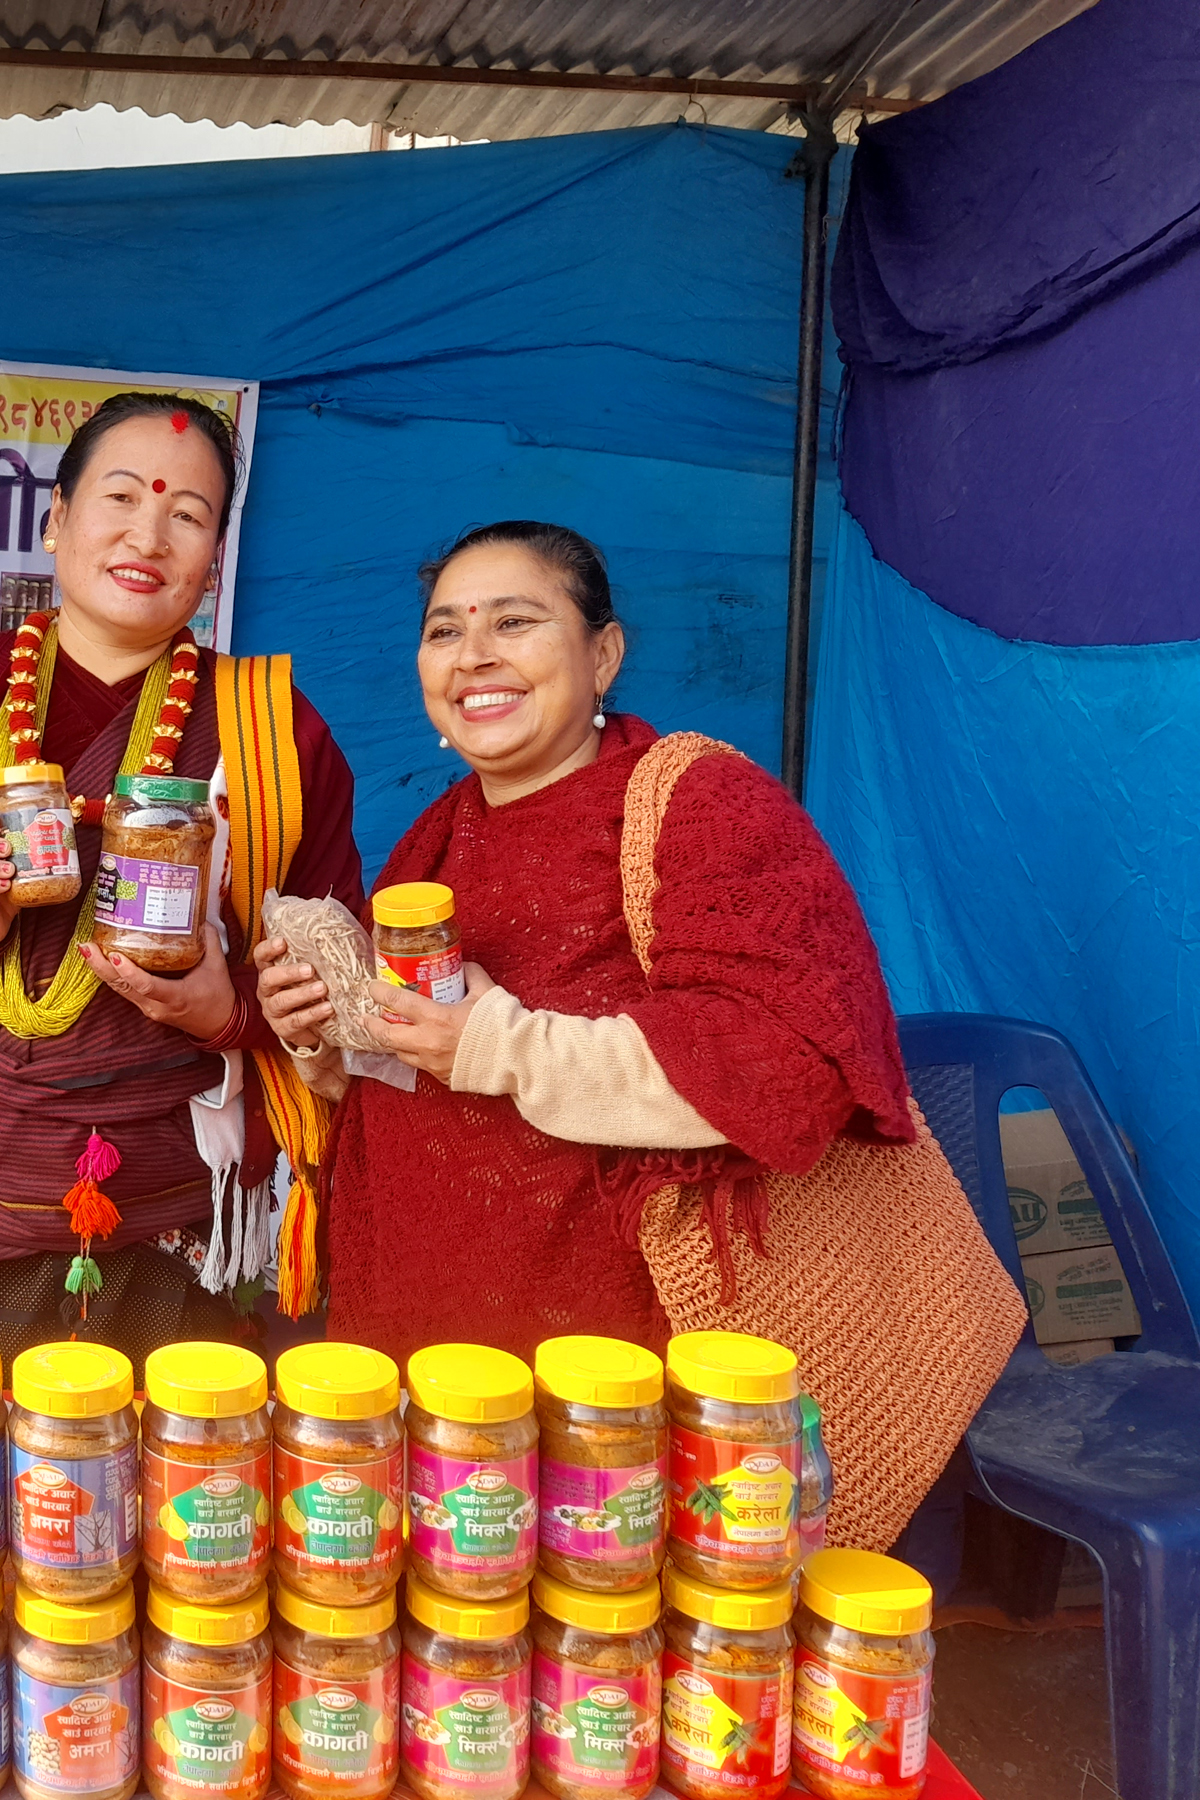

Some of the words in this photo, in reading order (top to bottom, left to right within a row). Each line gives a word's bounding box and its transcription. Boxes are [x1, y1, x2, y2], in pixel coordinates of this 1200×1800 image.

[51, 1490, 77, 1499] अचार
[30, 1512, 71, 1536] अमरा
[628, 1511, 662, 1530] मिक्स
[736, 1504, 781, 1524] करेला
[188, 1514, 252, 1539] कागती
[307, 1515, 374, 1537] कागती
[464, 1518, 508, 1538] मिक्स
[671, 1714, 713, 1744] करेला
[796, 1703, 835, 1738] करेला
[69, 1740, 111, 1759] अमरा
[179, 1740, 245, 1762] कागती
[303, 1730, 369, 1752] कागती
[457, 1734, 499, 1755] मिक्स
[583, 1730, 627, 1754] मिक्स
